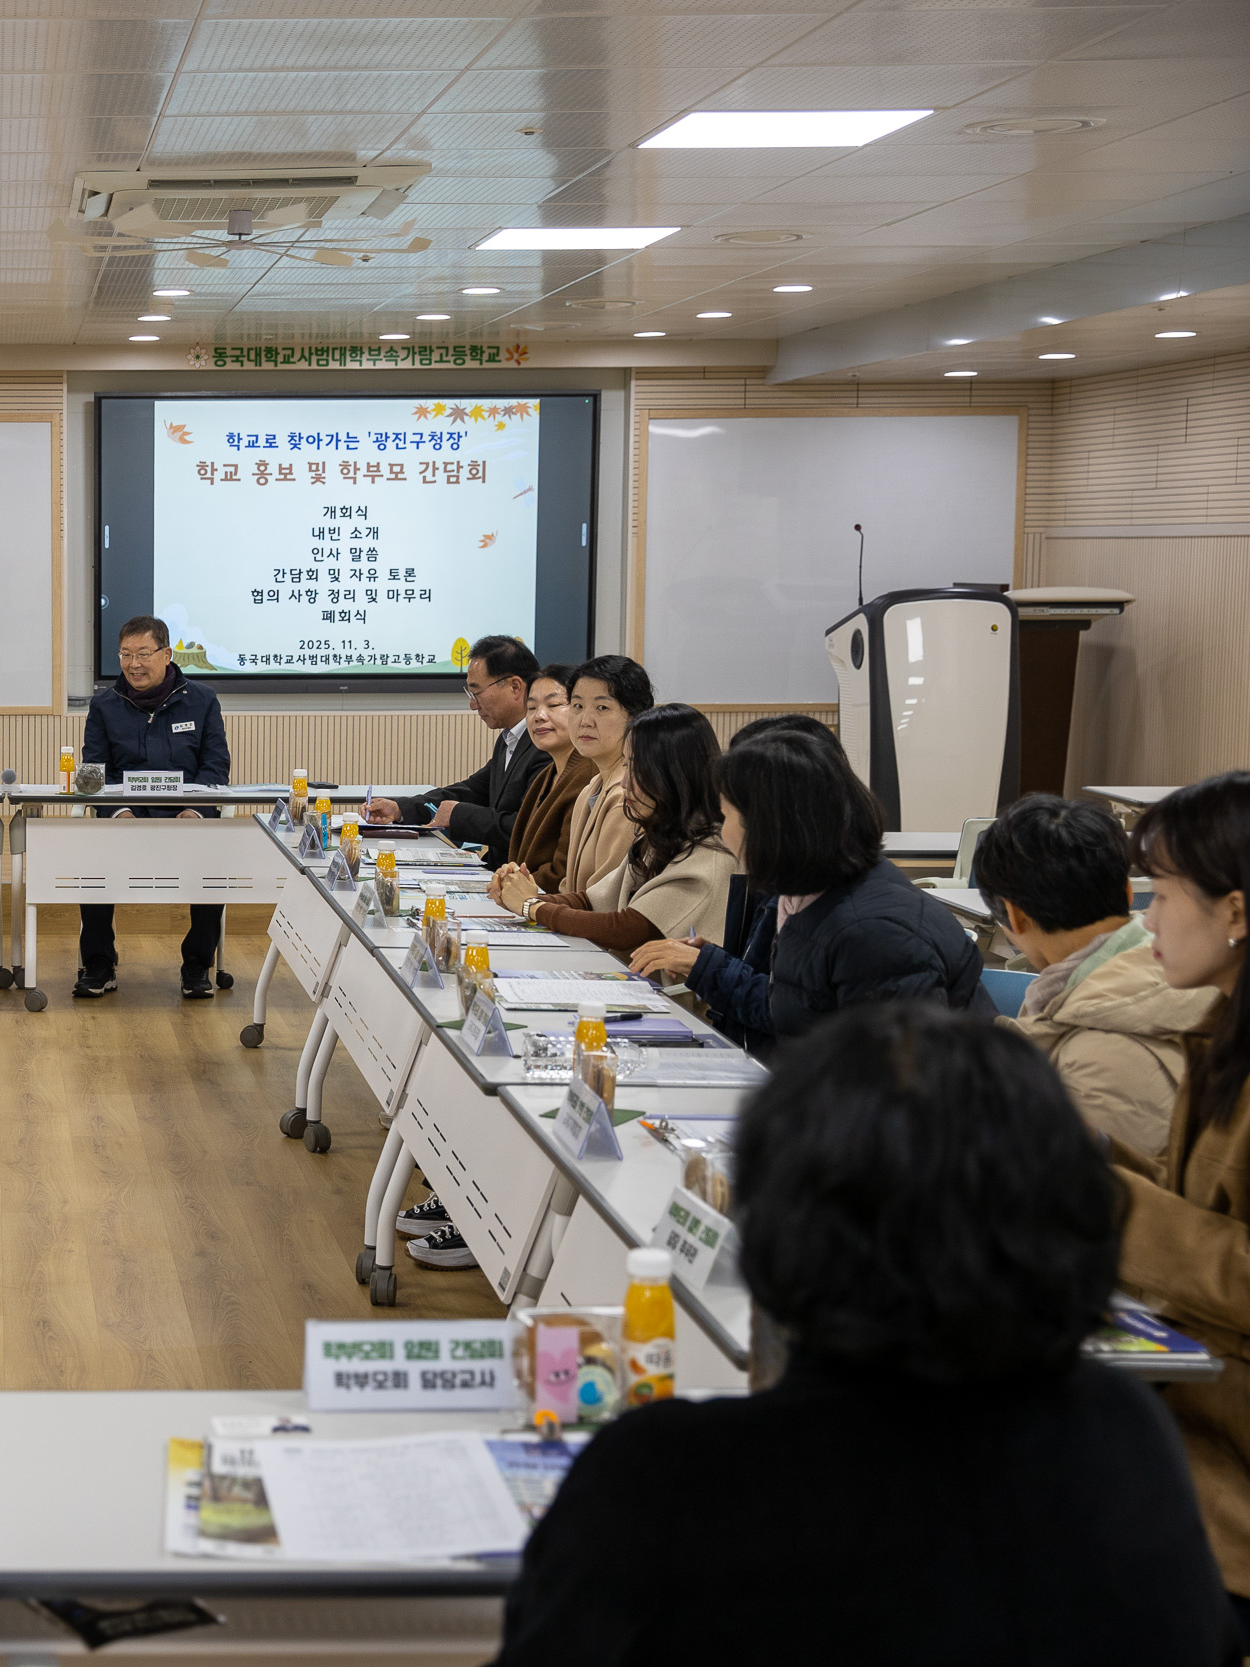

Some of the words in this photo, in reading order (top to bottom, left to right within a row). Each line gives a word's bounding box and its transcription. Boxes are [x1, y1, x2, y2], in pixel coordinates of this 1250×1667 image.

[212, 344, 502, 368] 동국대학교사범대학부속가람고등학교
[225, 431, 279, 451] 학교로
[287, 431, 360, 451] 찾아가는
[367, 430, 468, 452] '광진구청장'
[195, 460, 242, 486] 학교
[251, 459, 296, 486] 홍보
[307, 460, 326, 485] 및
[338, 459, 408, 485] 학부모
[419, 459, 487, 485] 간담회
[322, 504, 369, 521] 개회식
[311, 525, 342, 542] 내빈
[349, 525, 380, 542] 소개
[311, 546, 342, 563] 인사
[349, 546, 379, 563] 말씀
[273, 567, 320, 584] 간담회
[327, 567, 341, 584] 및
[349, 567, 379, 583] 자유
[387, 567, 417, 583] 토론
[250, 588, 280, 605] 협의
[288, 588, 319, 605] 사항
[327, 588, 357, 605] 정리
[365, 588, 378, 605] 및
[386, 587, 433, 604] 마무리
[321, 608, 368, 625] 폐회식
[299, 639, 336, 651] 2025.
[341, 639, 358, 651] 11.
[363, 639, 375, 651] 3.
[237, 653, 437, 667] 동국대학교사범대학부속가람고등학교
[334, 1369, 410, 1391] 학부모회
[419, 1369, 497, 1390] 담당교사
